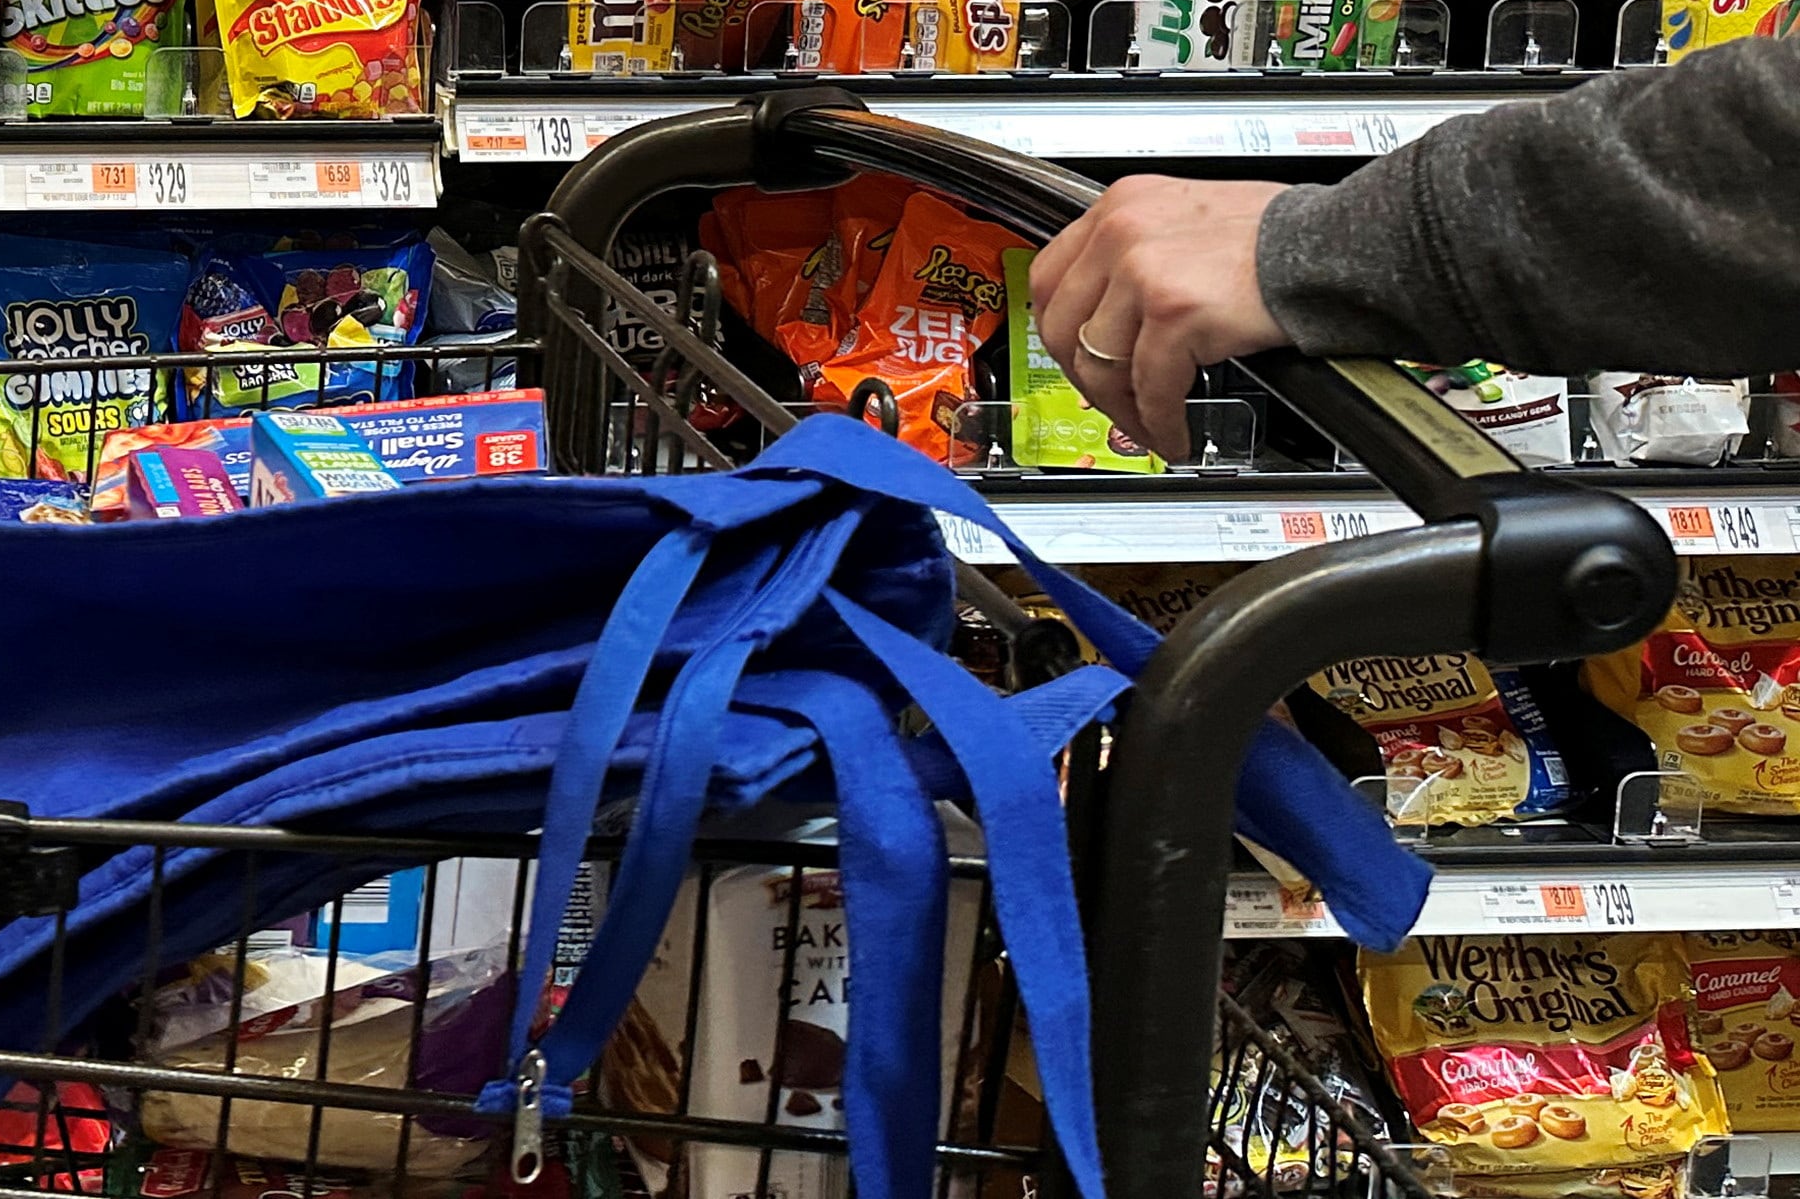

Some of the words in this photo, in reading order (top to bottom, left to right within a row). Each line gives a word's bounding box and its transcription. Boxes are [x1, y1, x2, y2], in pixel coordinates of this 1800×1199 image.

[9, 301, 135, 345] JOLLY
[49, 407, 119, 435] SOURS
[1499, 410, 1527, 421] CANDY
[1530, 405, 1551, 417] GEMS
[489, 448, 522, 466] 38
[1419, 937, 1617, 985] Werther's
[1695, 966, 1781, 992] Caramel
[1468, 984, 1636, 1031] Original
